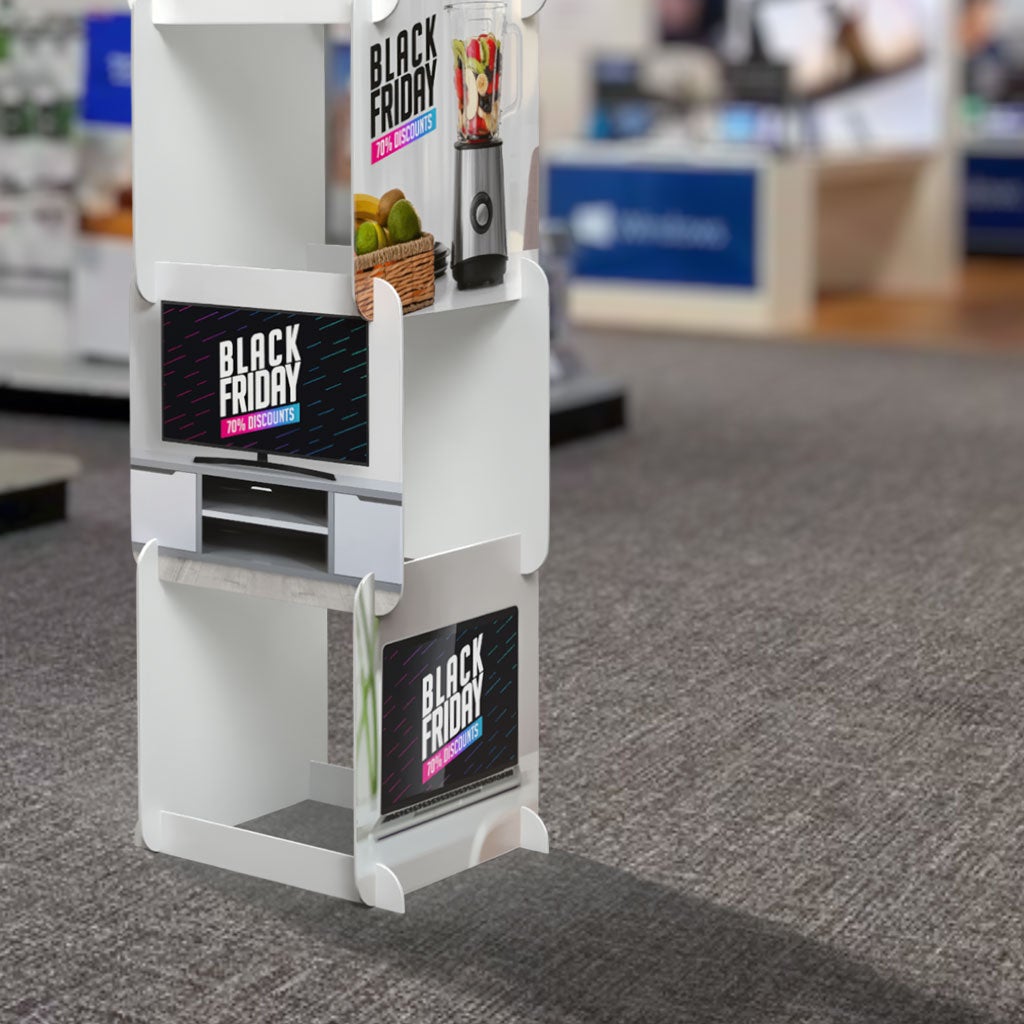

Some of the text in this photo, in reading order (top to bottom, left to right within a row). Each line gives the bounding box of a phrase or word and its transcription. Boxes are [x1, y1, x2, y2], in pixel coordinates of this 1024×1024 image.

[370, 14, 437, 91] BLACK
[370, 58, 437, 139] FRIDAY
[376, 113, 433, 158] 70% DISCOUNTS
[219, 323, 301, 378] BLACK
[219, 361, 301, 418] FRIDAY
[226, 407, 295, 434] 70% DISCOUNTS
[422, 632, 484, 718] BLACK
[422, 672, 484, 762] FRIDAY
[427, 723, 479, 777] 70% DISCOUNTS
